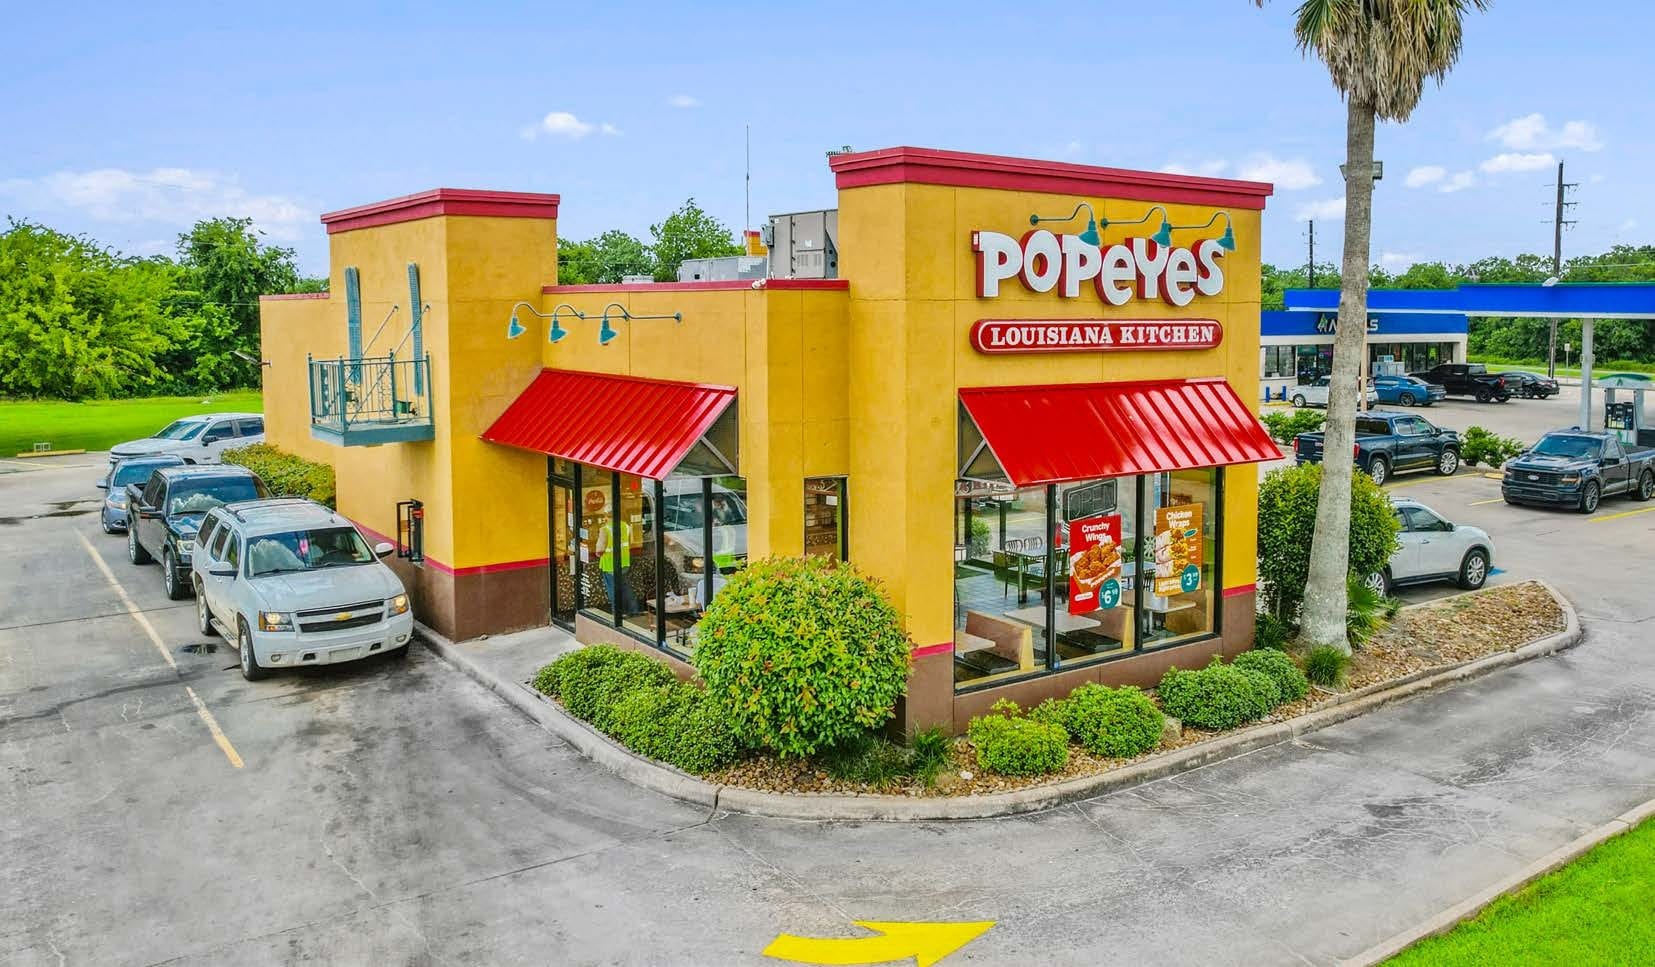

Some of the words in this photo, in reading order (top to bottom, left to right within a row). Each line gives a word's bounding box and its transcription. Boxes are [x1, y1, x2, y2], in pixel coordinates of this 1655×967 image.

[990, 325, 1114, 346] LOUISIANA
[1119, 325, 1215, 345] KITCHEN
[1070, 484, 1115, 518] OPEN
[1166, 511, 1193, 521] Chicken
[1081, 521, 1111, 534] Crunchy
[1168, 519, 1190, 529] Wraps
